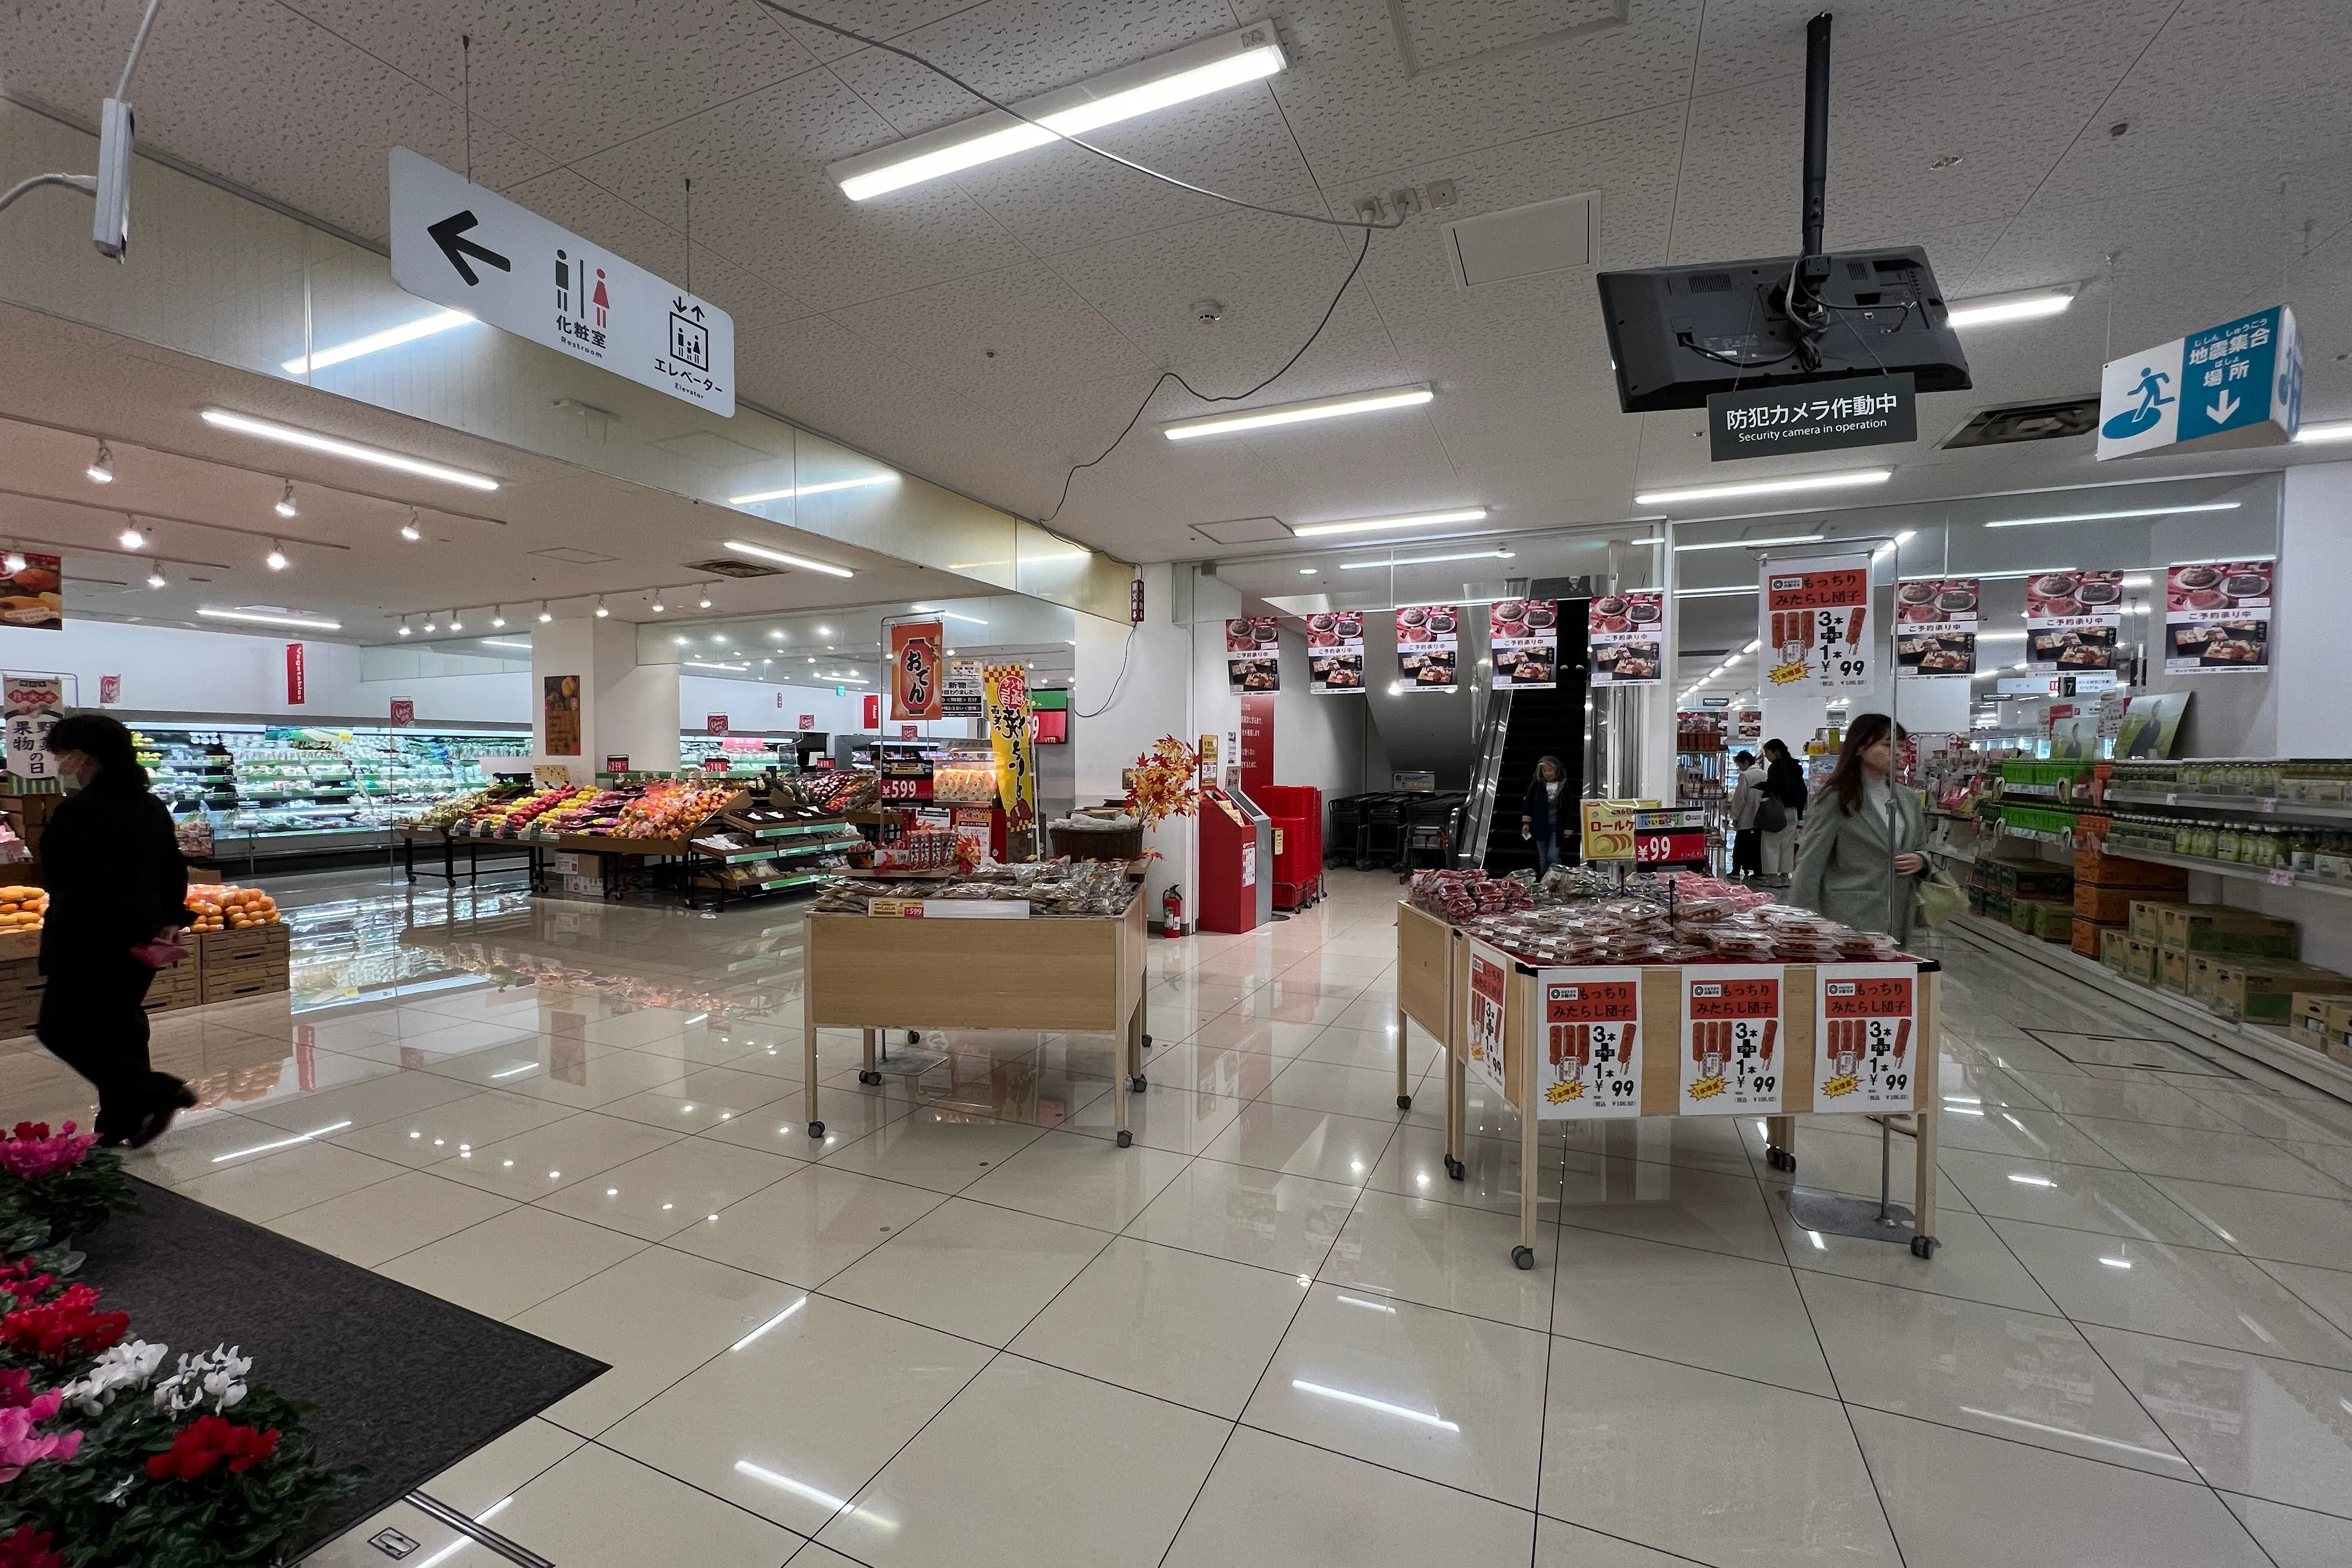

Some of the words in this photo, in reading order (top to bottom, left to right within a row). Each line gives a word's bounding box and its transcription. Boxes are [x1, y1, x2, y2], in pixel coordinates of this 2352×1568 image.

[556, 316, 607, 349] 化粧室
[561, 336, 603, 359] Restroom
[2189, 328, 2271, 365] 地震集合
[654, 359, 723, 393] エレベーター
[2203, 360, 2250, 387] 場所
[675, 382, 704, 400] Elevator
[1727, 393, 1898, 430] 防犯カメラ作動中
[1738, 430, 1780, 442] Security
[1783, 426, 1820, 438] camera
[1824, 425, 1833, 433] in
[1836, 419, 1887, 433] operation
[1804, 575, 1856, 589] もっちり
[1775, 590, 1860, 606] みたらし団子
[1818, 611, 1843, 626] 3本
[1819, 645, 1842, 660] 1本
[1840, 660, 1864, 676] 99
[906, 650, 931, 705] おでん
[881, 780, 916, 799] ¥599
[1637, 836, 1671, 862] ¥99
[1578, 987, 1626, 1000] もっちり
[1721, 984, 1769, 997] もっちり
[1856, 983, 1902, 996] もっちり
[1553, 1005, 1631, 1017] みたらし団子
[1696, 1001, 1773, 1014] みたらし団子
[1831, 1000, 1906, 1013] みたらし団子
[1593, 1026, 1616, 1042] 3本
[1735, 1022, 1758, 1039] 3本
[1869, 1021, 1892, 1038] 3本
[1594, 1063, 1615, 1079] 1本
[1736, 1059, 1756, 1075] 1本
[1869, 1057, 1889, 1073] 1本
[1612, 1080, 1634, 1097] 99
[1753, 1076, 1776, 1093] 99
[1885, 1074, 1908, 1090] 99
